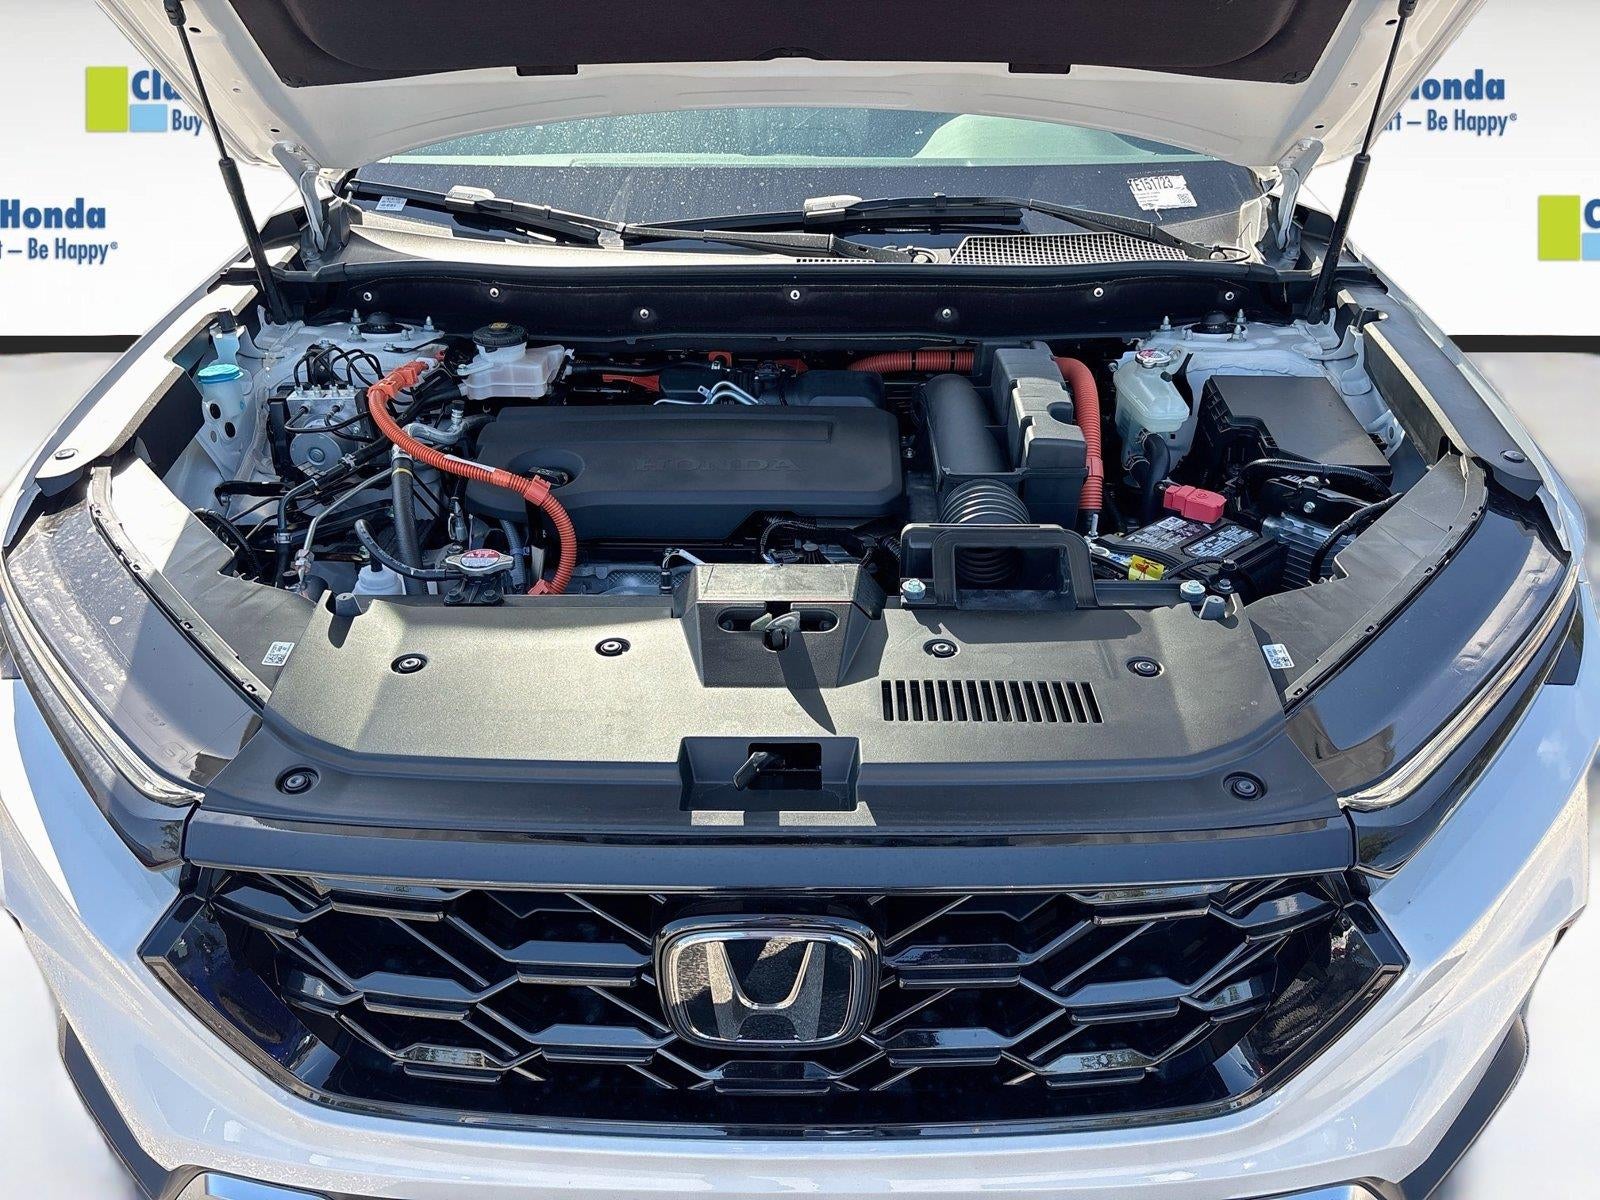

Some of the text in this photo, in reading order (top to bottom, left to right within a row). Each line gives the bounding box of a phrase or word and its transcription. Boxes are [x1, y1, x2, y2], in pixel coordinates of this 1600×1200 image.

[1411, 69, 1505, 100] onda
[172, 109, 202, 136] Buy
[1427, 109, 1448, 131] Be
[0, 198, 106, 229] Honda
[28, 237, 49, 260] Be
[632, 456, 801, 472] HONDA
